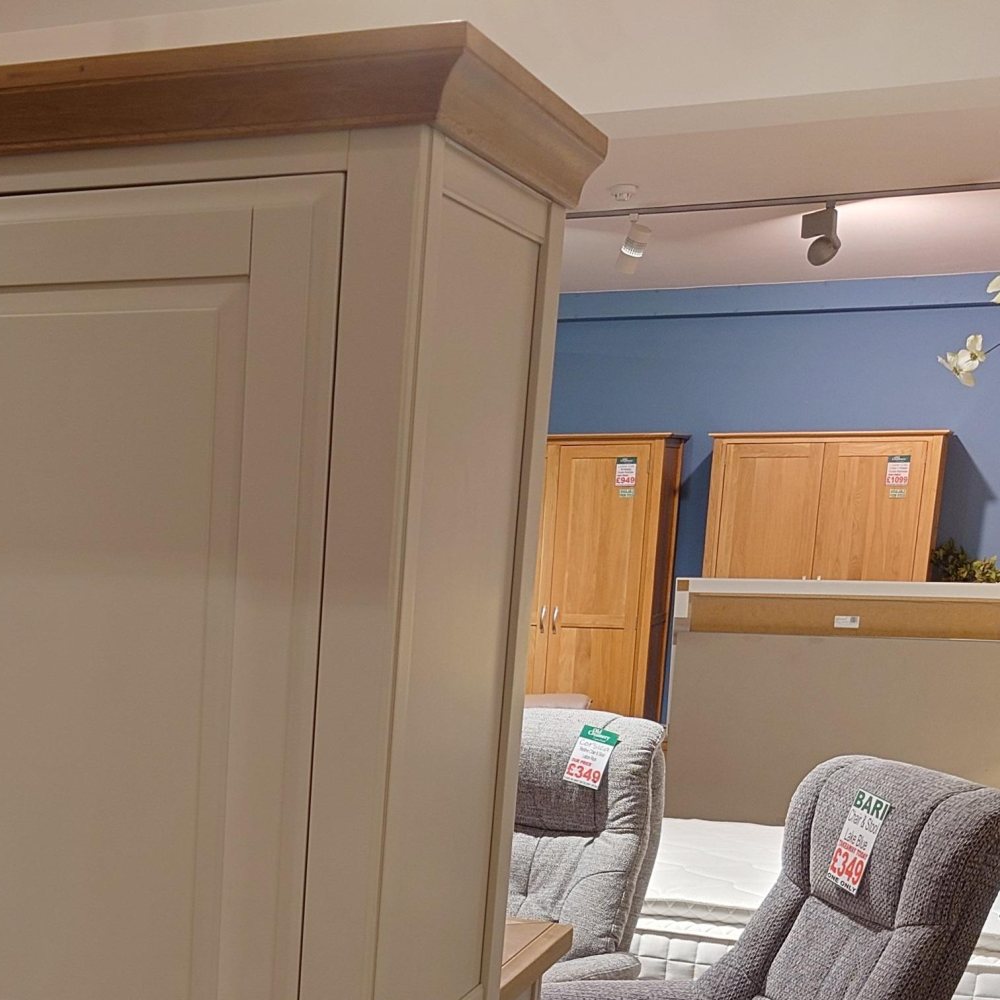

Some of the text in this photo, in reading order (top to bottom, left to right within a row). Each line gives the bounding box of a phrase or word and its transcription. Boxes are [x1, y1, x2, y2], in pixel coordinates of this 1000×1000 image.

[616, 476, 635, 484] £949
[567, 763, 601, 784] £349
[853, 790, 889, 820] BARI
[829, 847, 864, 885] £349
[827, 872, 857, 893] ONE ONLY
